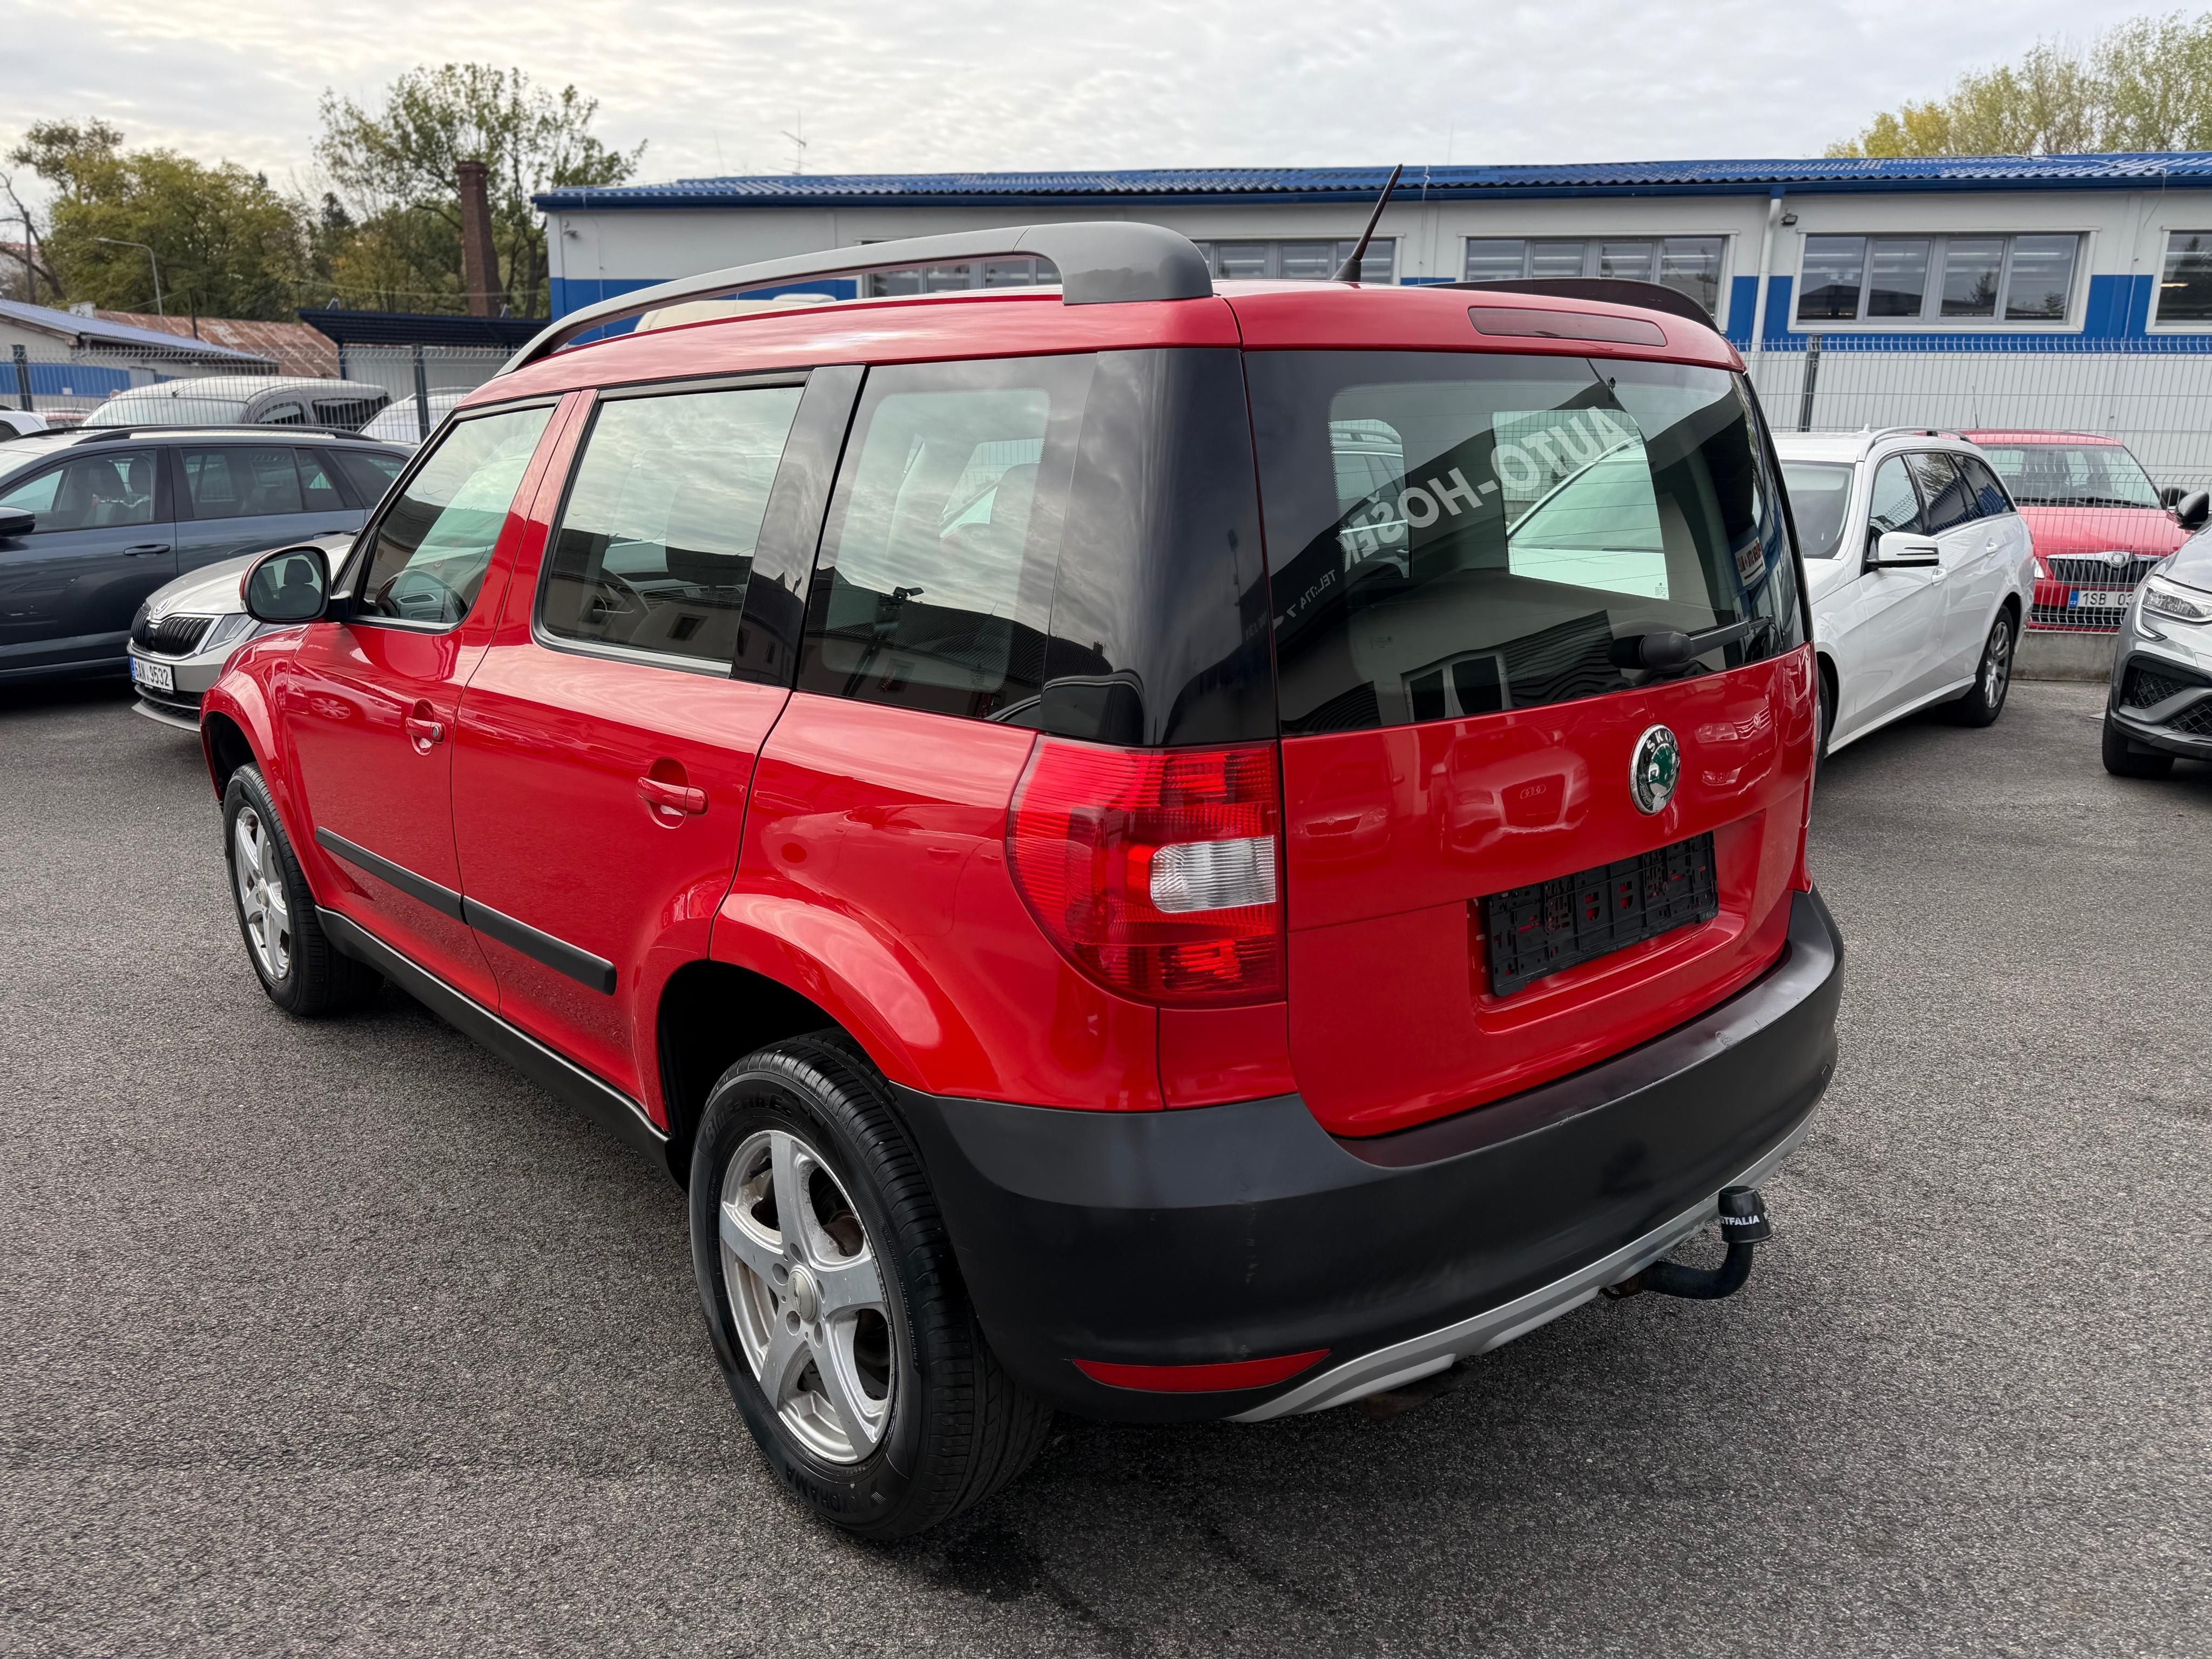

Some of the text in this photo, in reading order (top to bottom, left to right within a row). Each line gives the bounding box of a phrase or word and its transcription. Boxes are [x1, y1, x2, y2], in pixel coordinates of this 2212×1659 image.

[2083, 593, 2133, 606] 1SB 03
[149, 665, 170, 686] 9532
[1719, 1215, 1761, 1225] STFALIA
